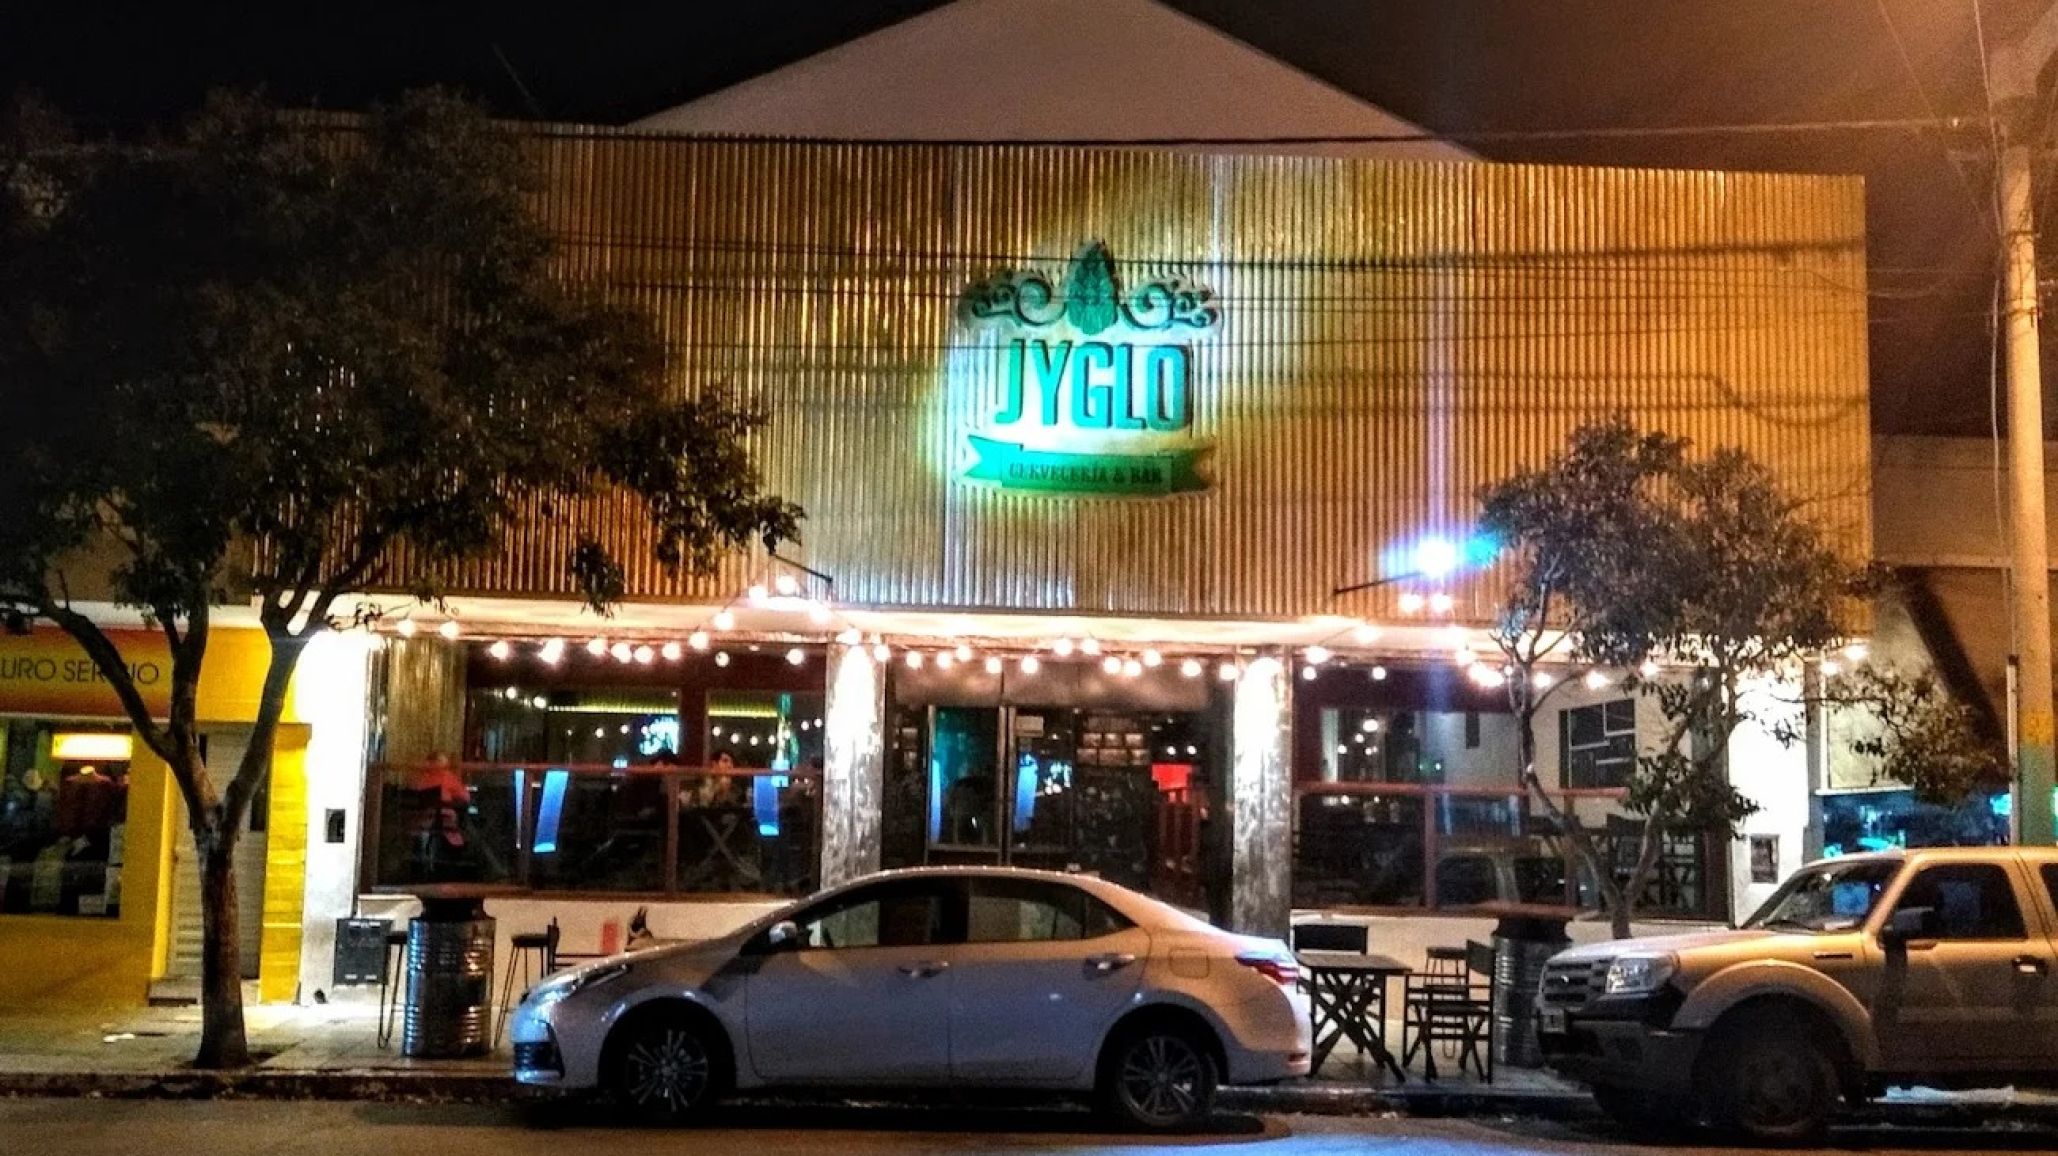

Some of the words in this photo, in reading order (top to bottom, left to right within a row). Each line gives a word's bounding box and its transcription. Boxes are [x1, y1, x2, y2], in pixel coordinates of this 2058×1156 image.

[994, 338, 1194, 431] JYGLO
[1113, 465, 1126, 484] &
[1131, 466, 1163, 484] BAR
[63, 658, 159, 685] SERIO
